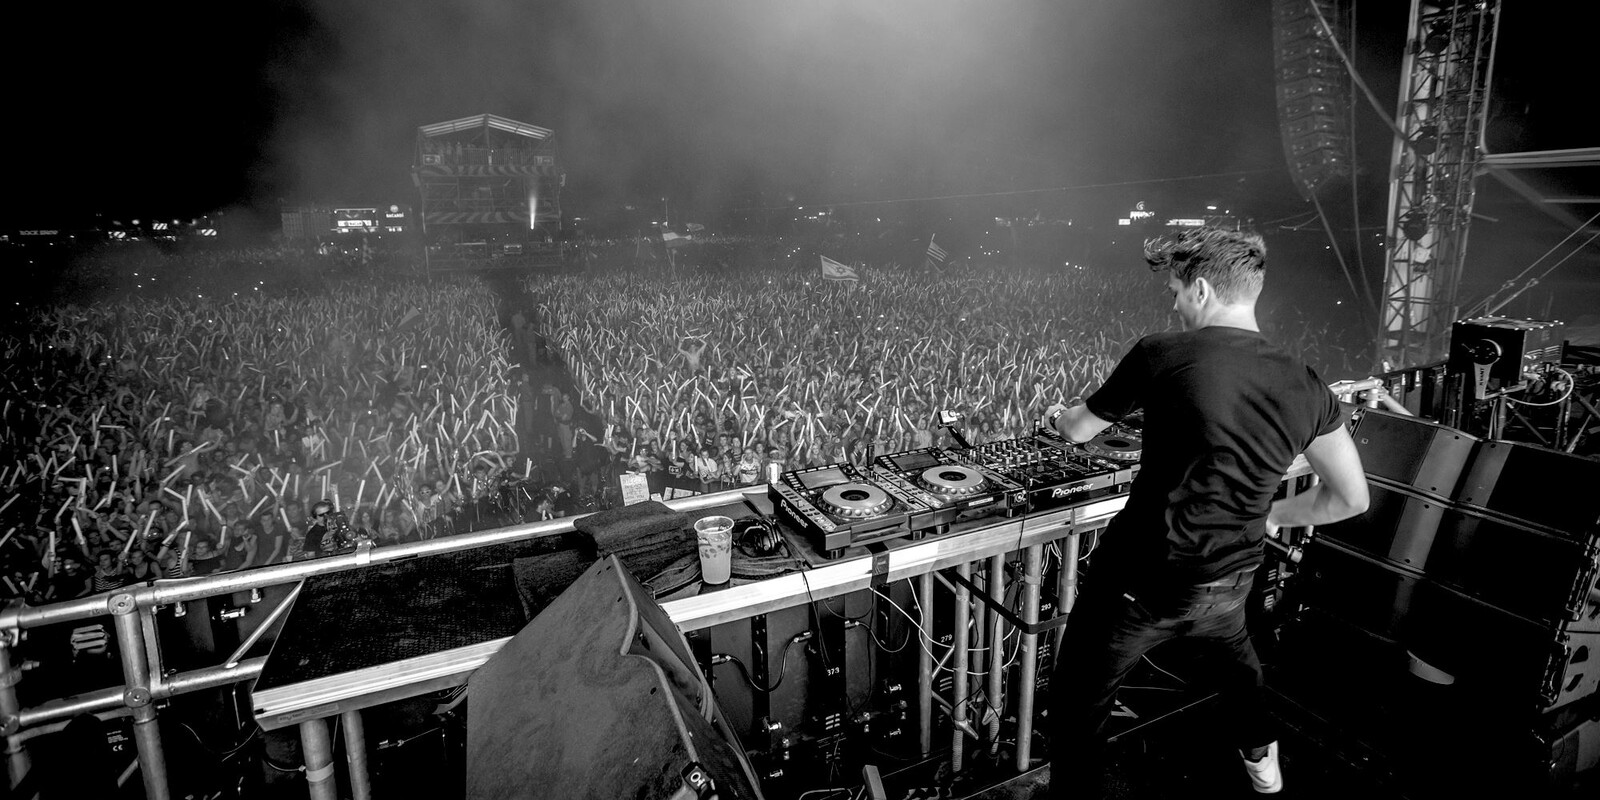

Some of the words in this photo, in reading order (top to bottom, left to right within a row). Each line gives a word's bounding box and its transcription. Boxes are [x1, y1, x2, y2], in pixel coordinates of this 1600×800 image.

[1052, 483, 1094, 498] Pioneer
[780, 499, 808, 529] Pioneer
[940, 634, 953, 643] 279
